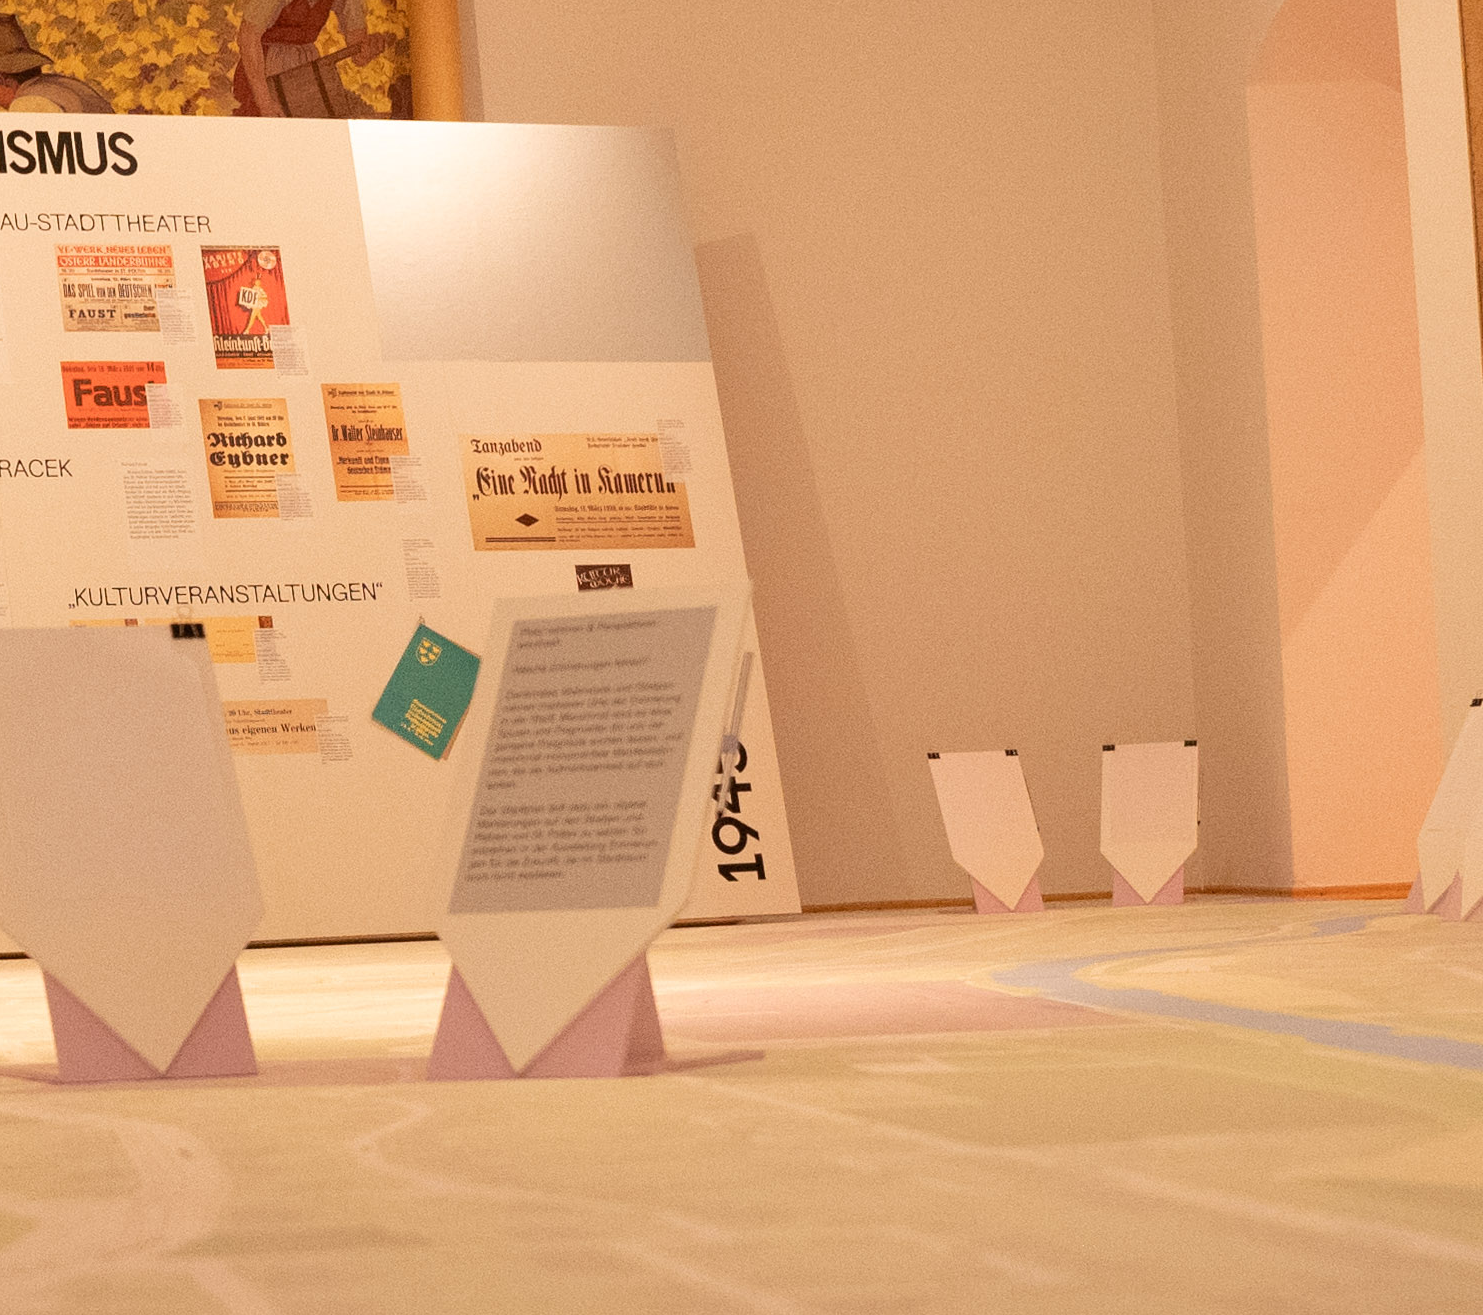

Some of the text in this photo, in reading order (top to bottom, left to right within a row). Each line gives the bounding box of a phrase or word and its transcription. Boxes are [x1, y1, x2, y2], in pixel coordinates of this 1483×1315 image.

[69, 309, 116, 318] FAUST
[73, 378, 154, 406] Faus
[207, 432, 287, 449] Richard
[470, 438, 542, 456] Tanzabend
[209, 450, 289, 468] Eybner
[519, 465, 569, 501] Nacht
[574, 468, 591, 494] in
[242, 725, 277, 735] eigenen
[280, 723, 317, 733] Werken
